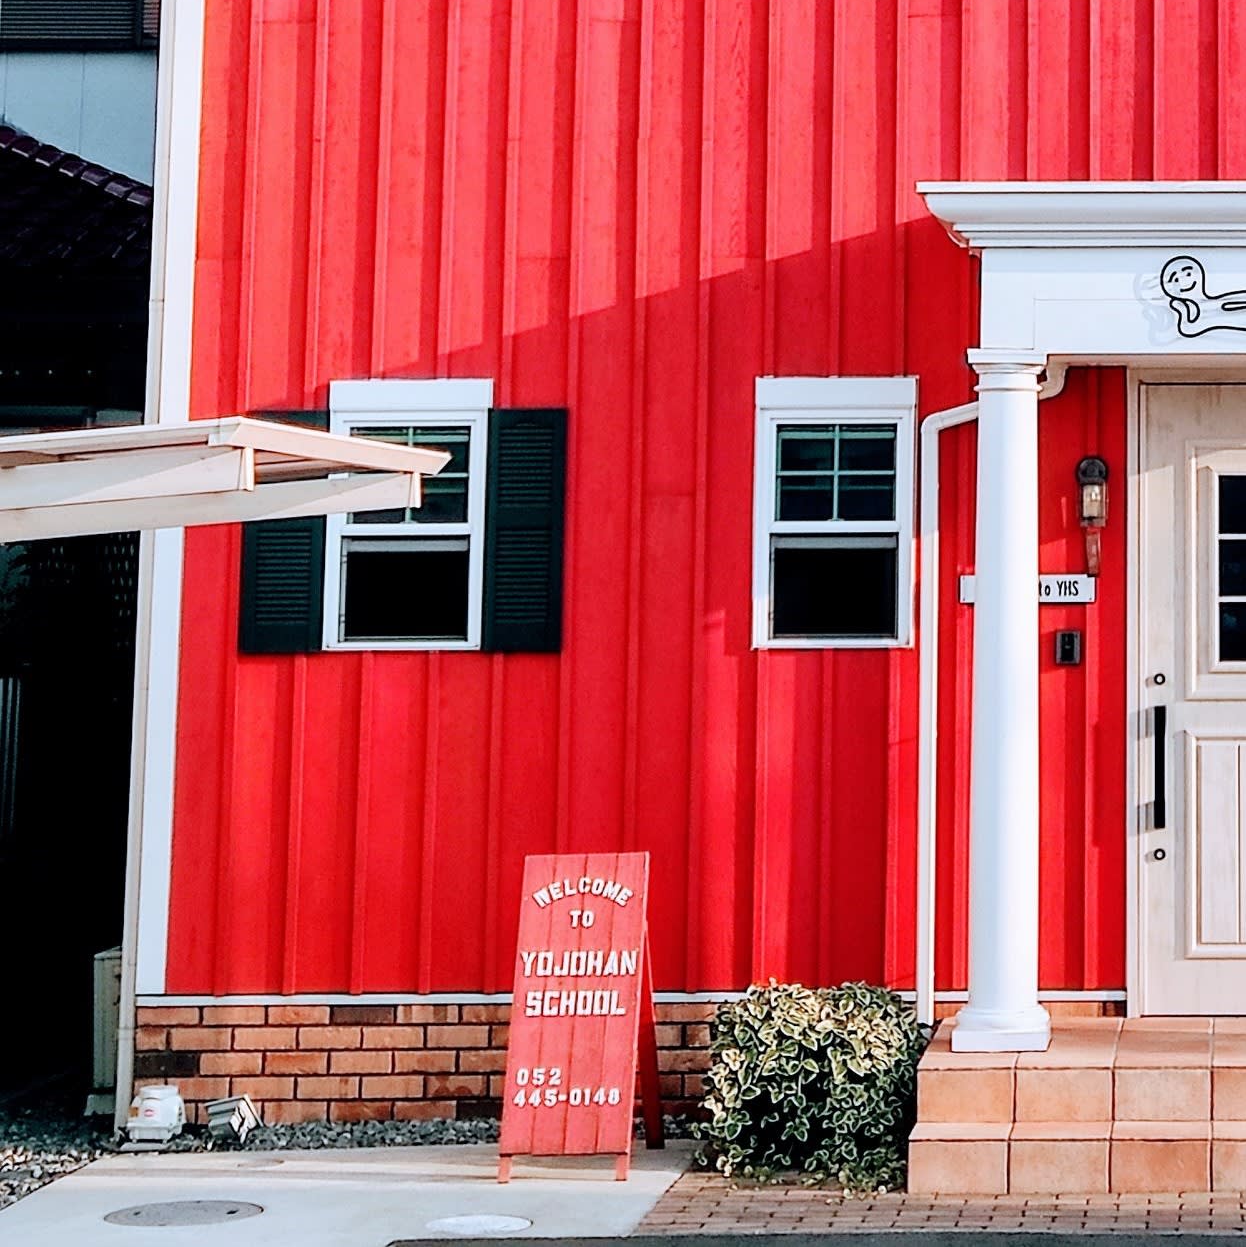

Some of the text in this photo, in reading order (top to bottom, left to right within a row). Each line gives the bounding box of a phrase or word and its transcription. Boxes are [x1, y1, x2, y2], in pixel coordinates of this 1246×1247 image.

[1056, 580, 1079, 597] YHS
[532, 875, 634, 908] WELCOME
[569, 909, 595, 928] TO
[520, 950, 638, 978] YOJOHAN
[524, 989, 627, 1018] SCHOOL
[516, 1067, 562, 1086] 052
